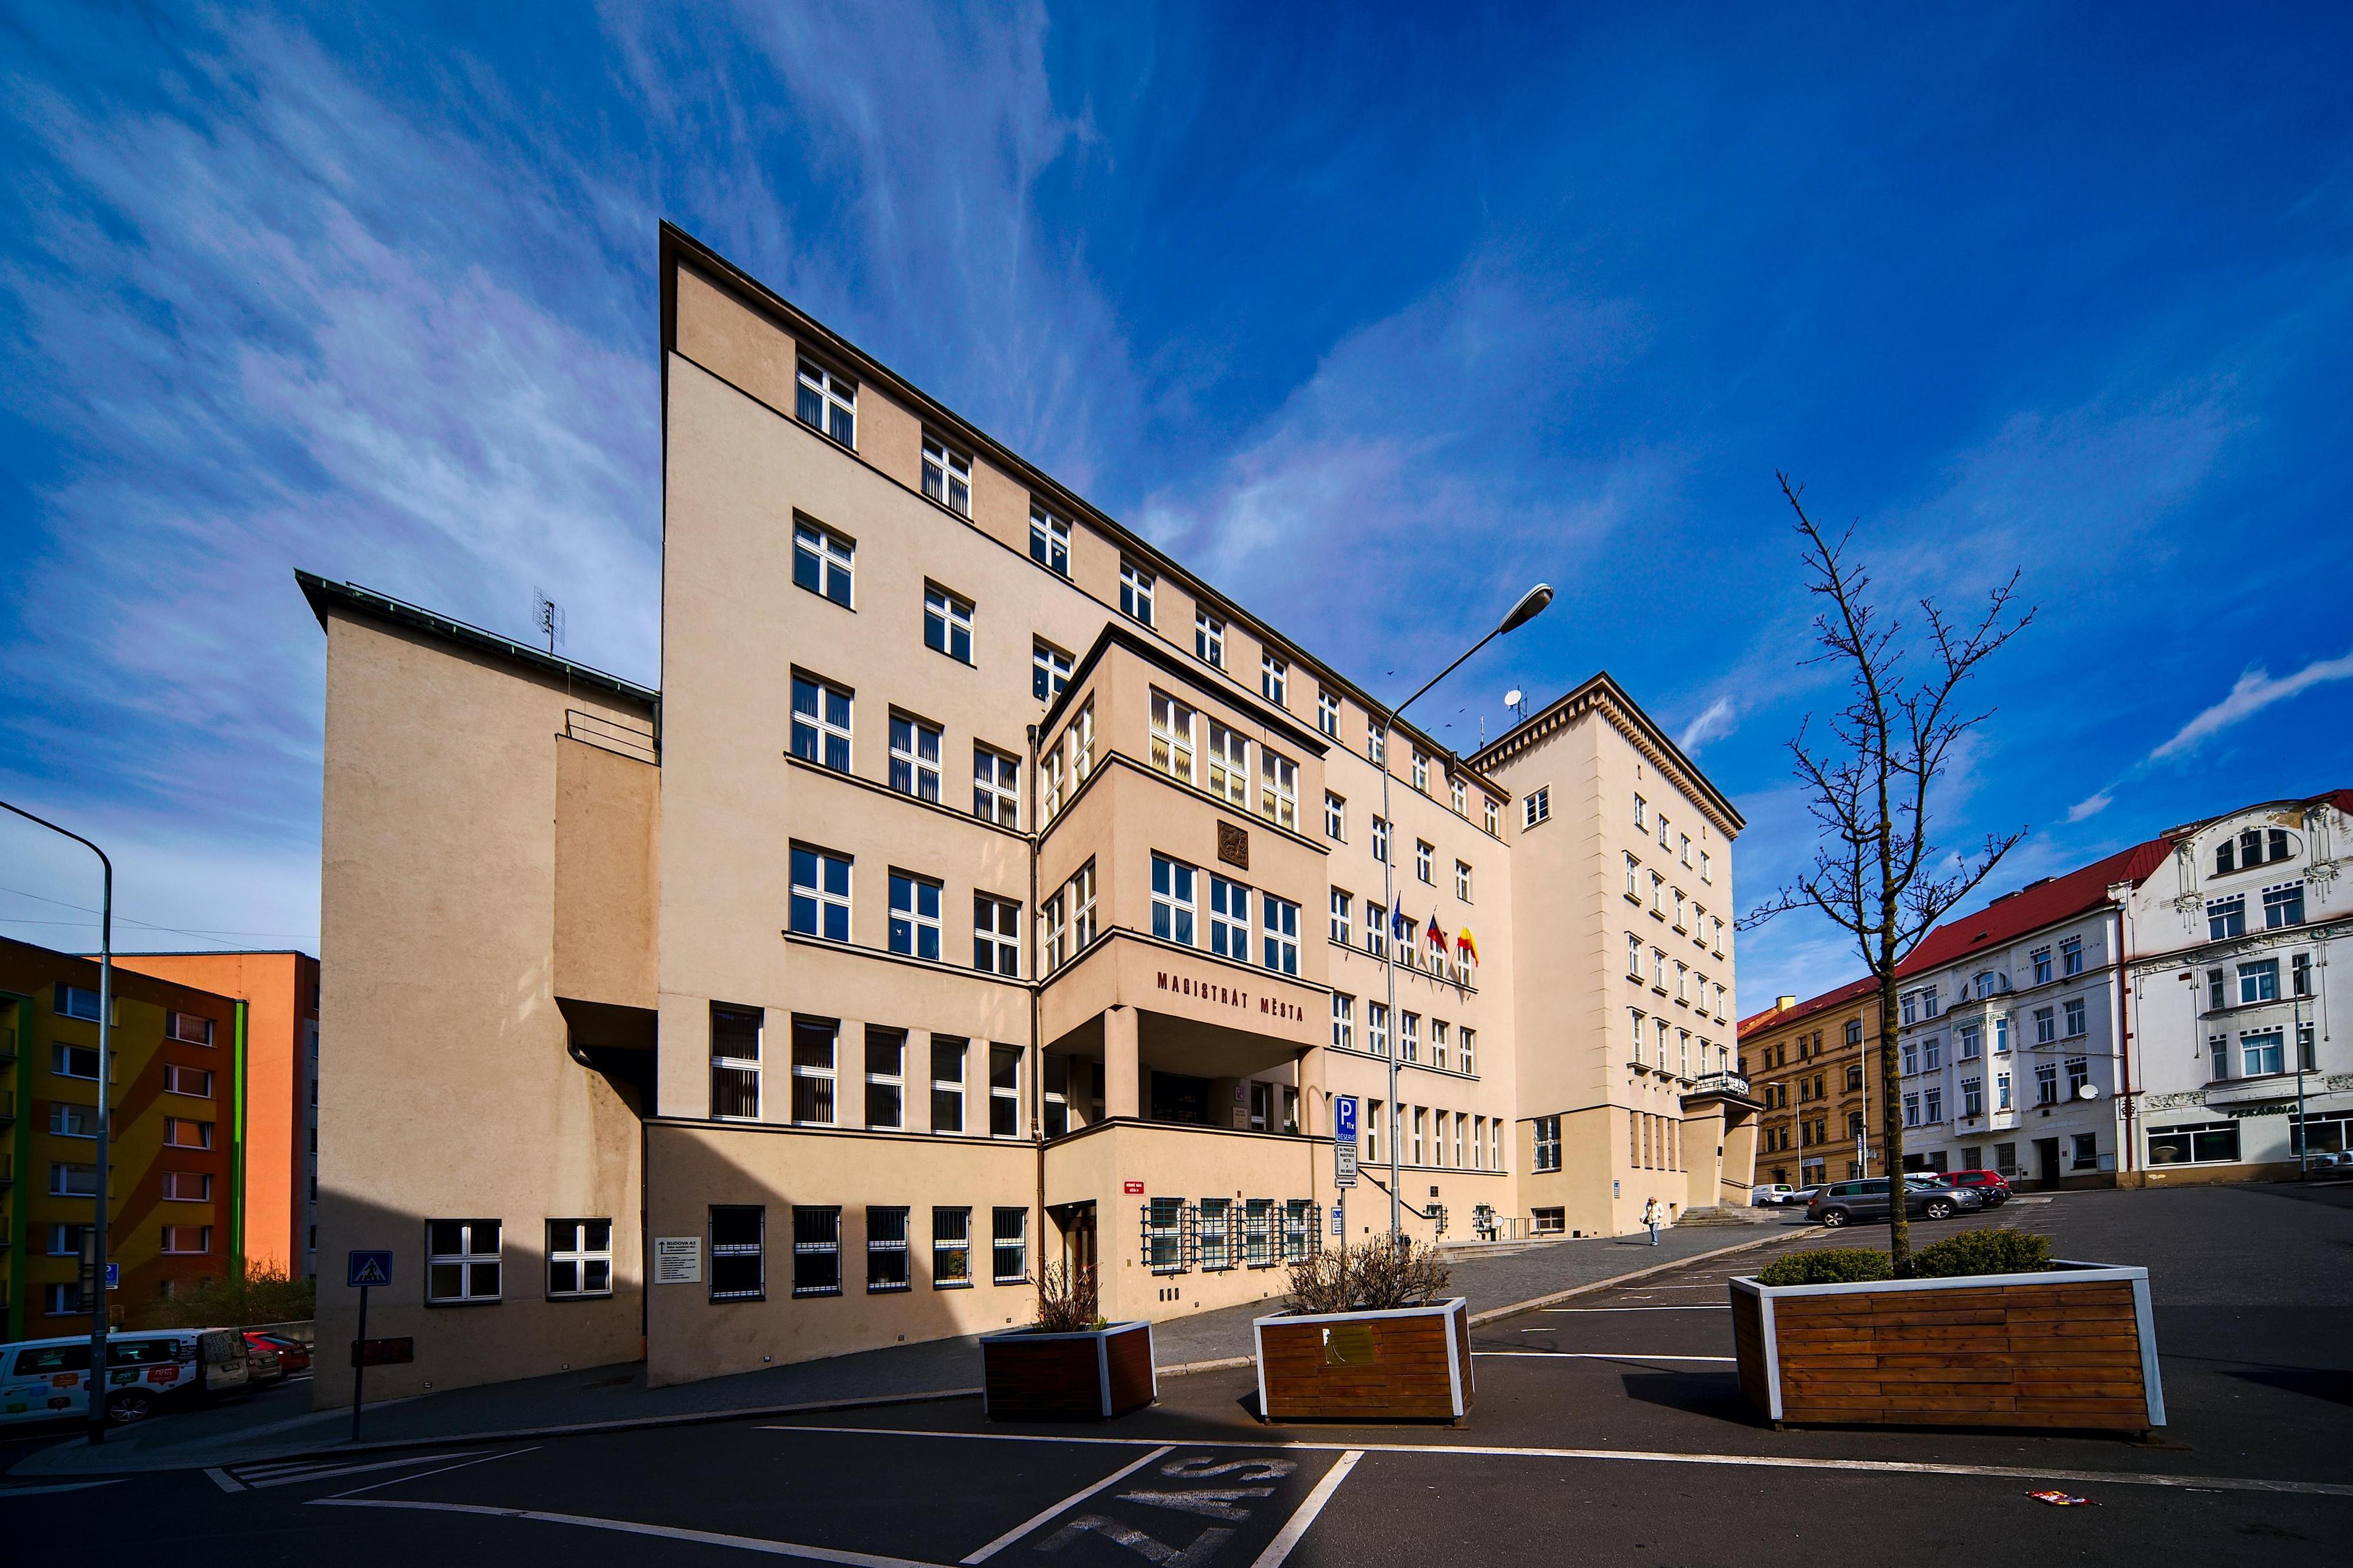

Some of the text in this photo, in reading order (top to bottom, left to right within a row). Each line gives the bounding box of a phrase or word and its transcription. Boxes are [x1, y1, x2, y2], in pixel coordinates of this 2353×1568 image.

[1157, 971, 1304, 1022] MAGISTRÁT MĚSTA
[1341, 1100, 1352, 1125] P
[2228, 1105, 2298, 1119] PEKÁRNA
[1346, 1122, 1355, 1130] 11x
